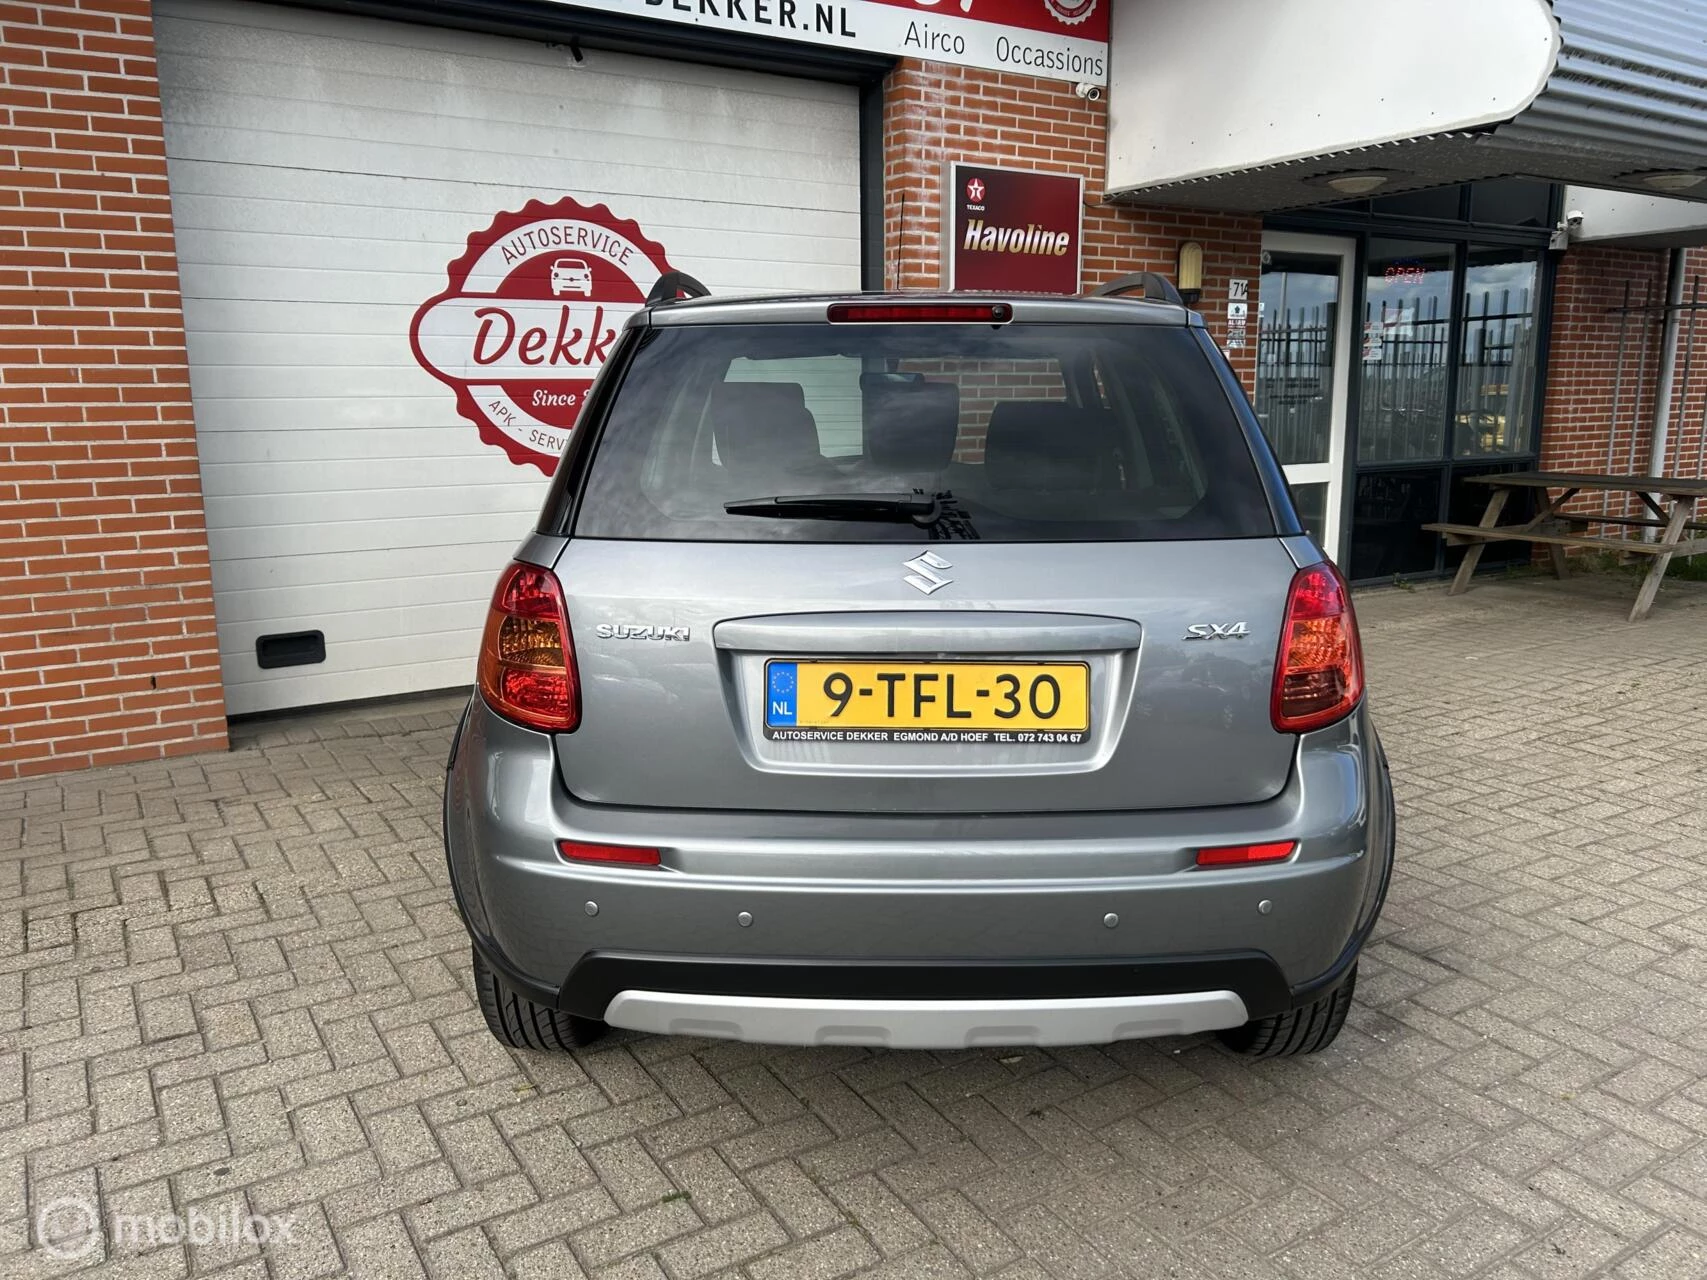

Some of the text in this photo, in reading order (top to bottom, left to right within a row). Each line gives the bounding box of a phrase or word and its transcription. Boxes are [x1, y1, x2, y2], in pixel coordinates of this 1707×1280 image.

[645, 0, 857, 38] KER.NL
[904, 21, 1104, 77] Airco Occassions
[501, 226, 634, 266] AUTOSERVICE
[963, 219, 1070, 256] Havoline
[1384, 267, 1425, 285] OPEN
[473, 304, 617, 366] Dekk
[532, 389, 576, 406] Since
[488, 400, 517, 427] APK
[529, 429, 568, 451] SERV
[596, 623, 690, 642] SUZUKI
[1182, 621, 1252, 641] SX4
[772, 672, 1062, 720] NL 9-TFL-30
[772, 731, 1082, 743] AUTOSERVICE DEKKER EGMOND A/D HOEF TEL. 072 743 04 67
